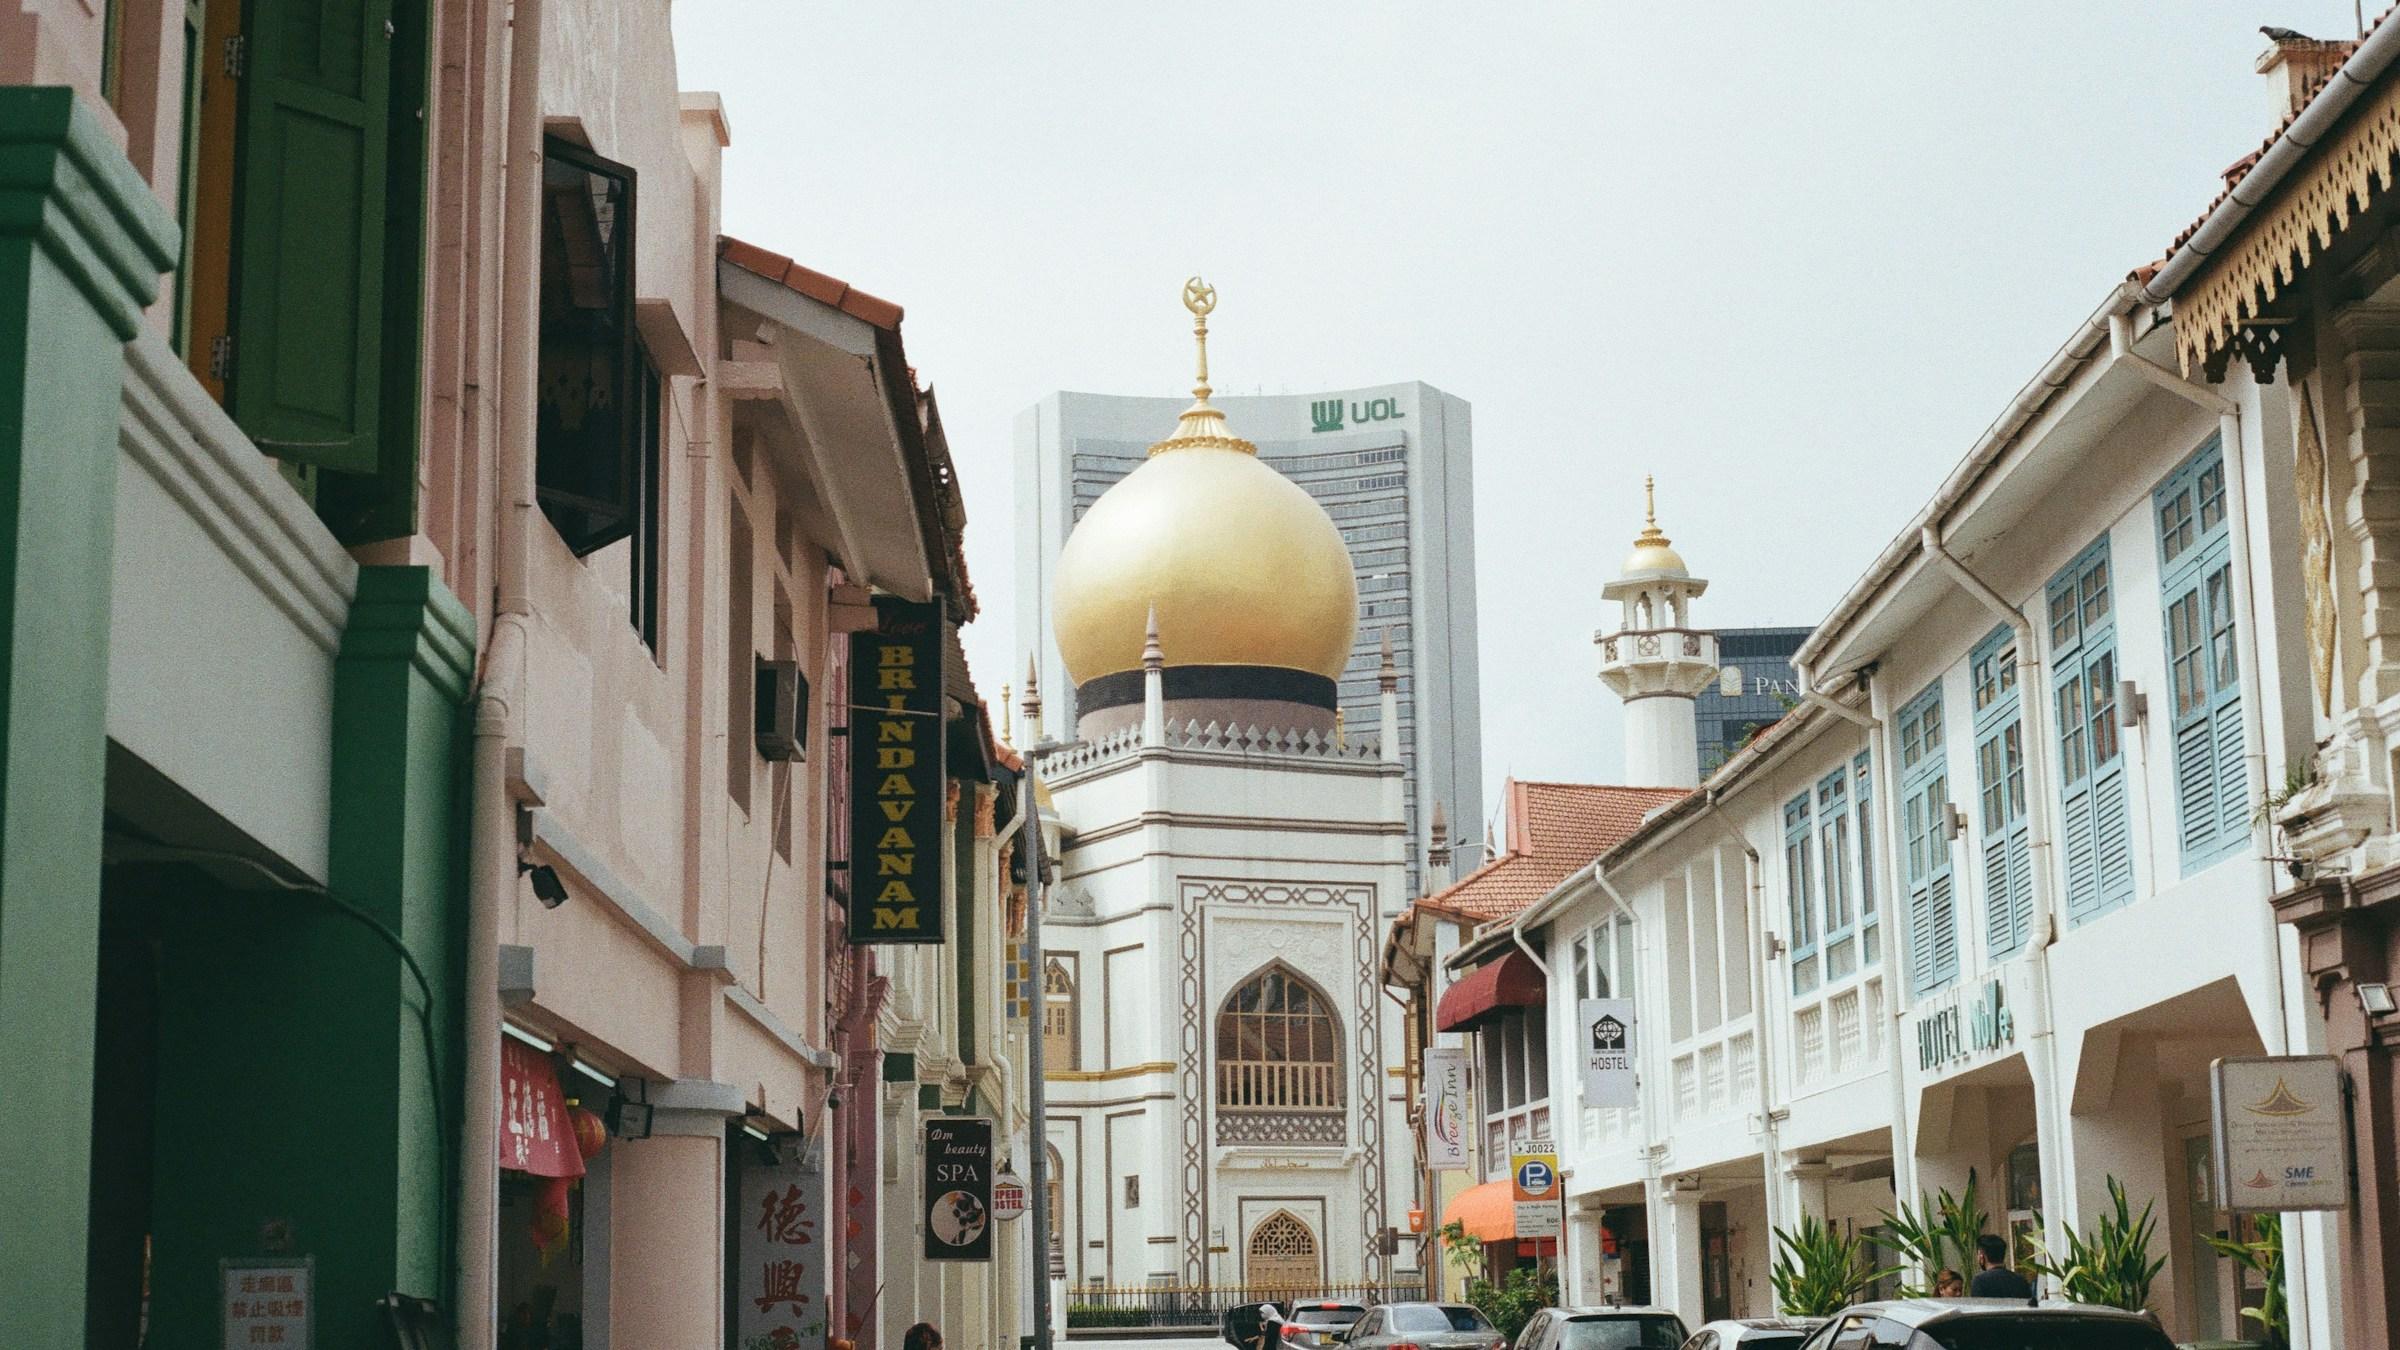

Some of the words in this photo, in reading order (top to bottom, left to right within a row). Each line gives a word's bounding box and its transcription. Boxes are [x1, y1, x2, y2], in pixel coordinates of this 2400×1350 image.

[1351, 398, 1405, 424] UOL
[873, 645, 919, 930] BRINDAVANAM
[1917, 1004, 1967, 1071] HOTEL
[1591, 1056, 1629, 1071] HOSTEL
[1444, 1063, 1458, 1099] Inn
[1447, 1100, 1463, 1158] Breeze
[944, 1143, 986, 1157] beauty
[937, 1164, 979, 1181] SPA
[2285, 1166, 2314, 1179] SME
